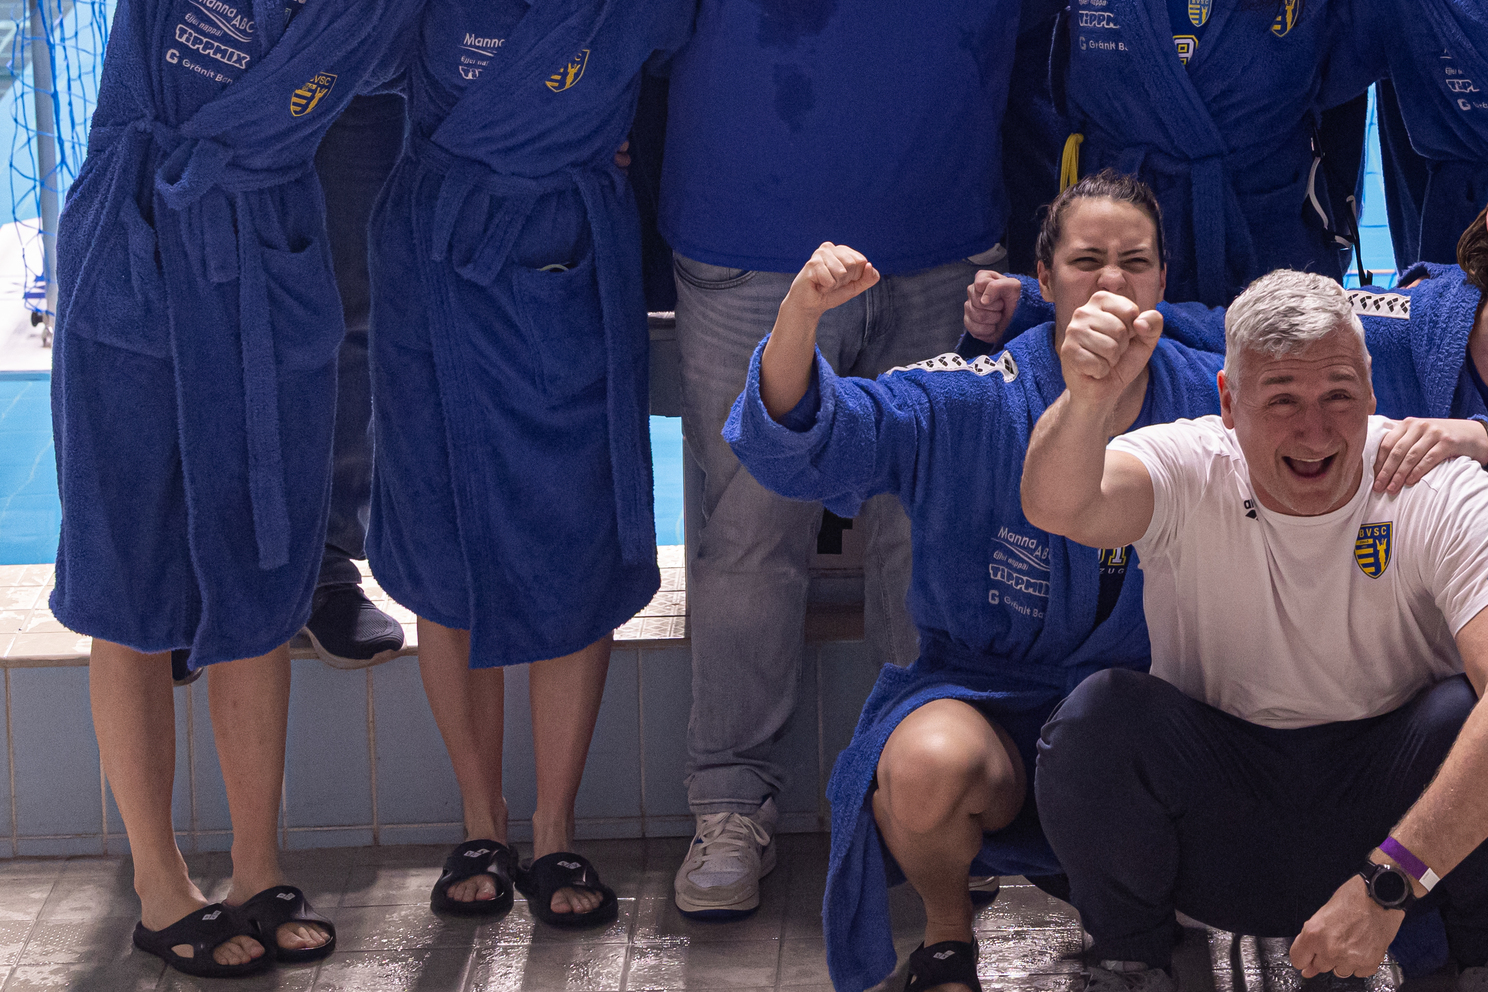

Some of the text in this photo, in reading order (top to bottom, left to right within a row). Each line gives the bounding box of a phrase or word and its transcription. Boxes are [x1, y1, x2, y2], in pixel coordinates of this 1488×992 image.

[182, 59, 215, 78] Gránit
[215, 74, 233, 85] Ban
[310, 74, 331, 86] VSC
[1359, 526, 1387, 538] BVSC
[997, 526, 1050, 560] Manna AB
